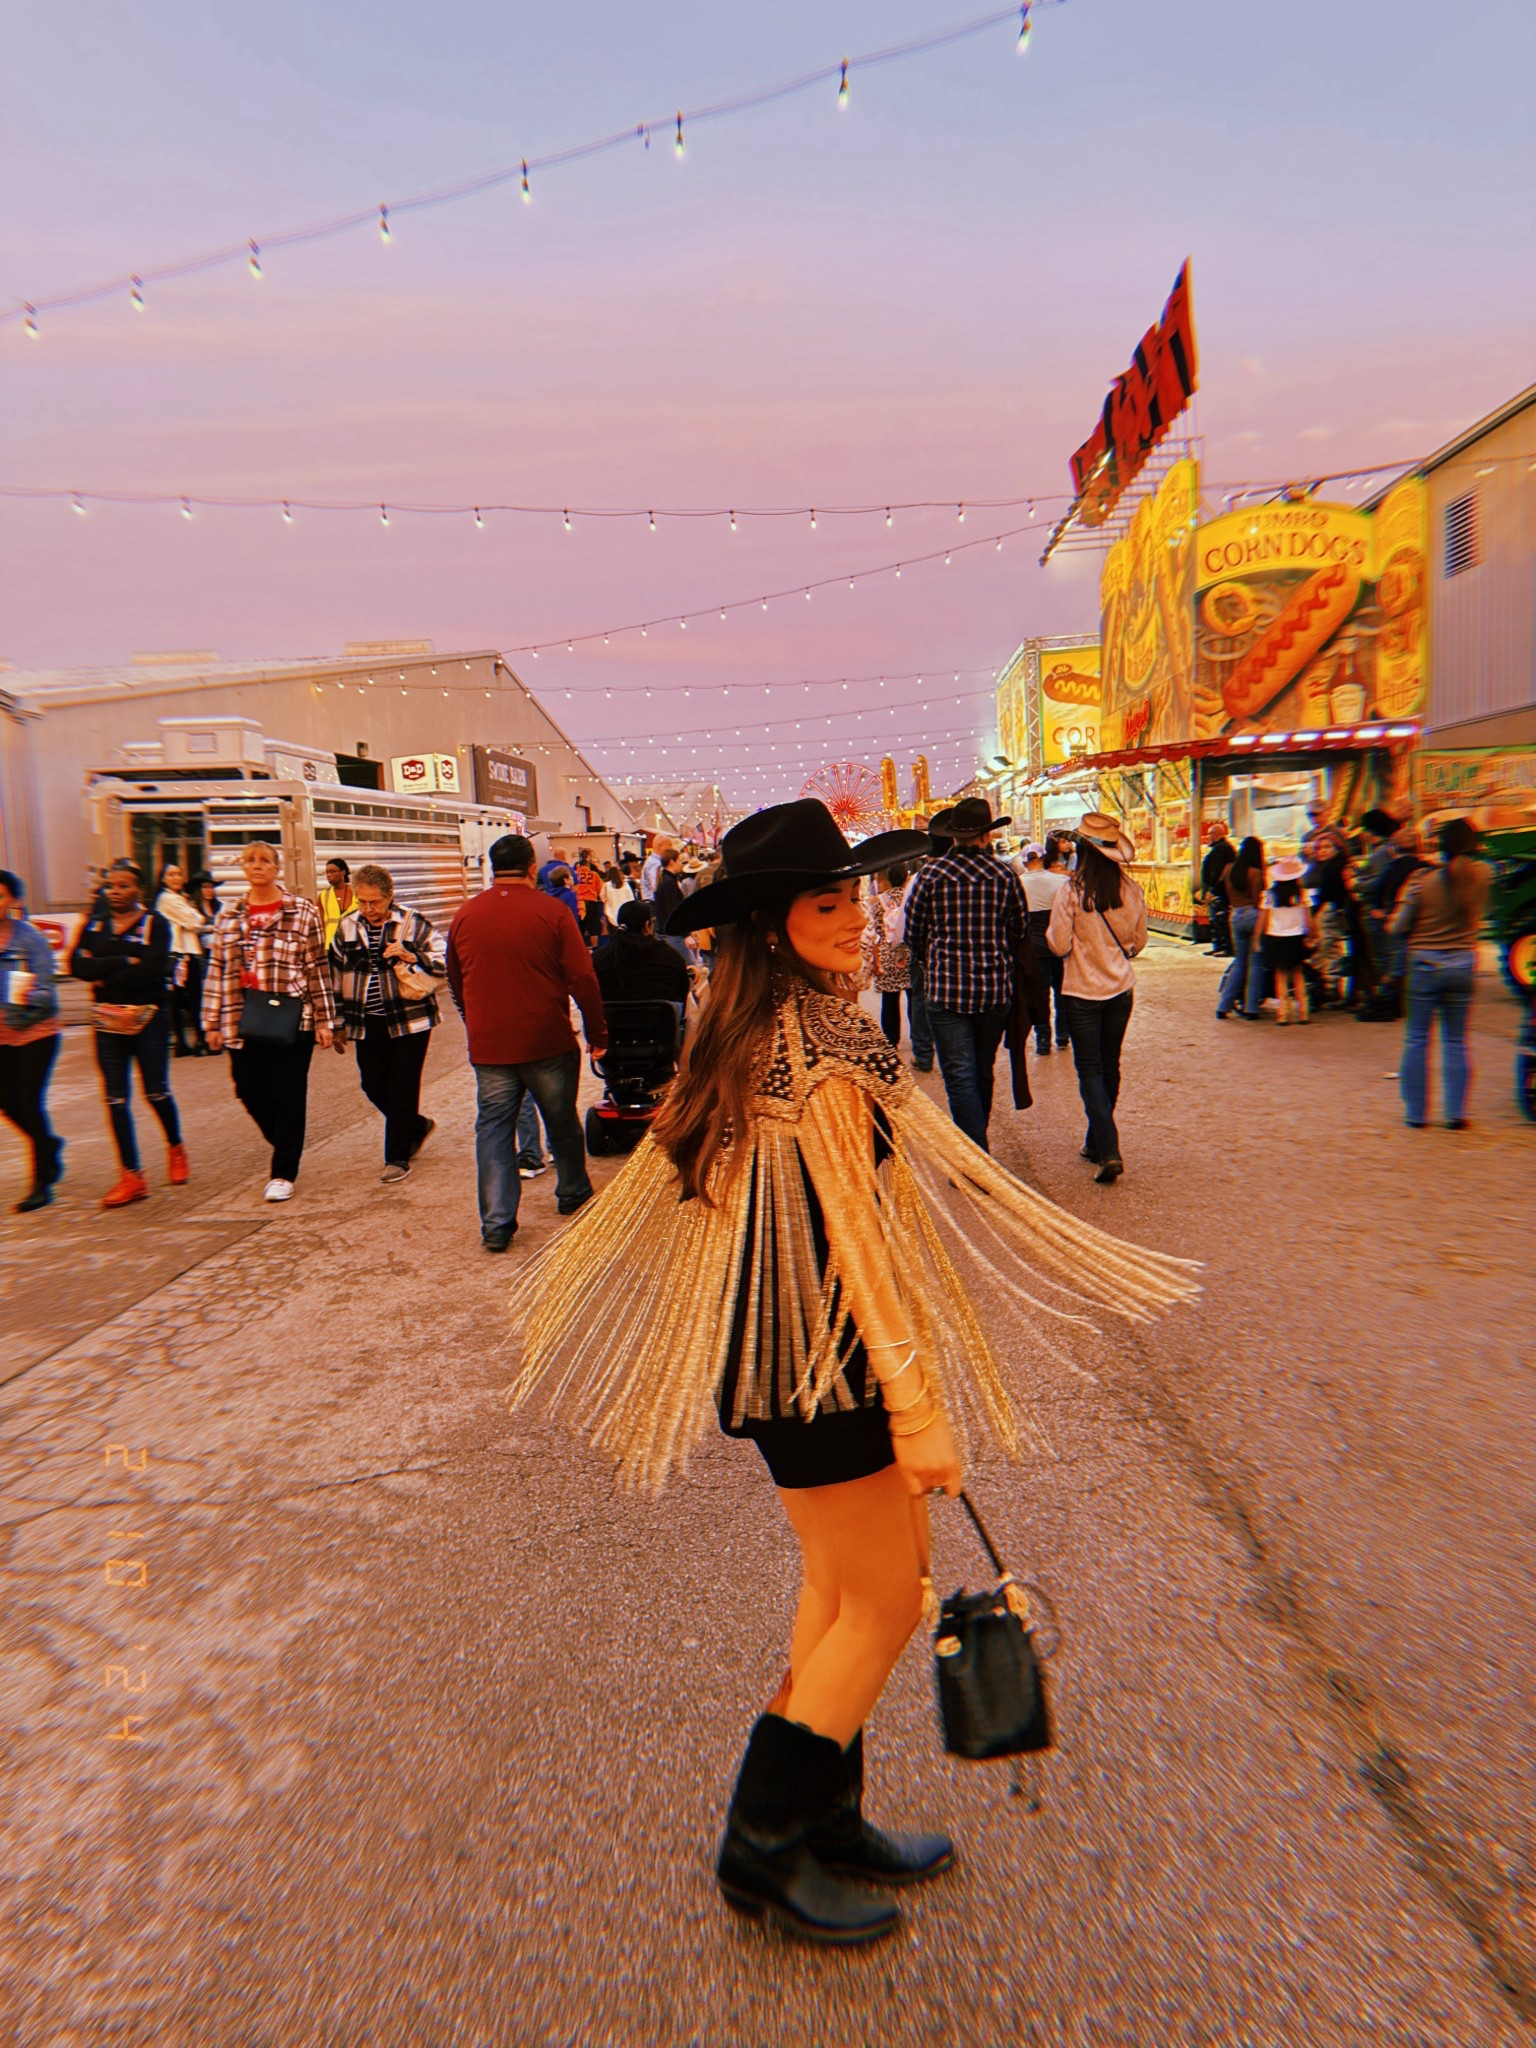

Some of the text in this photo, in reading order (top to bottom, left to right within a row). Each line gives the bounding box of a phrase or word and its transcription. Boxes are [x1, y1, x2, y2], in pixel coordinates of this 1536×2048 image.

[1238, 510, 1329, 534] JUMBO
[1204, 531, 1368, 573] CORN DOGS
[488, 759, 510, 784] SWINE
[580, 872, 593, 885] 22
